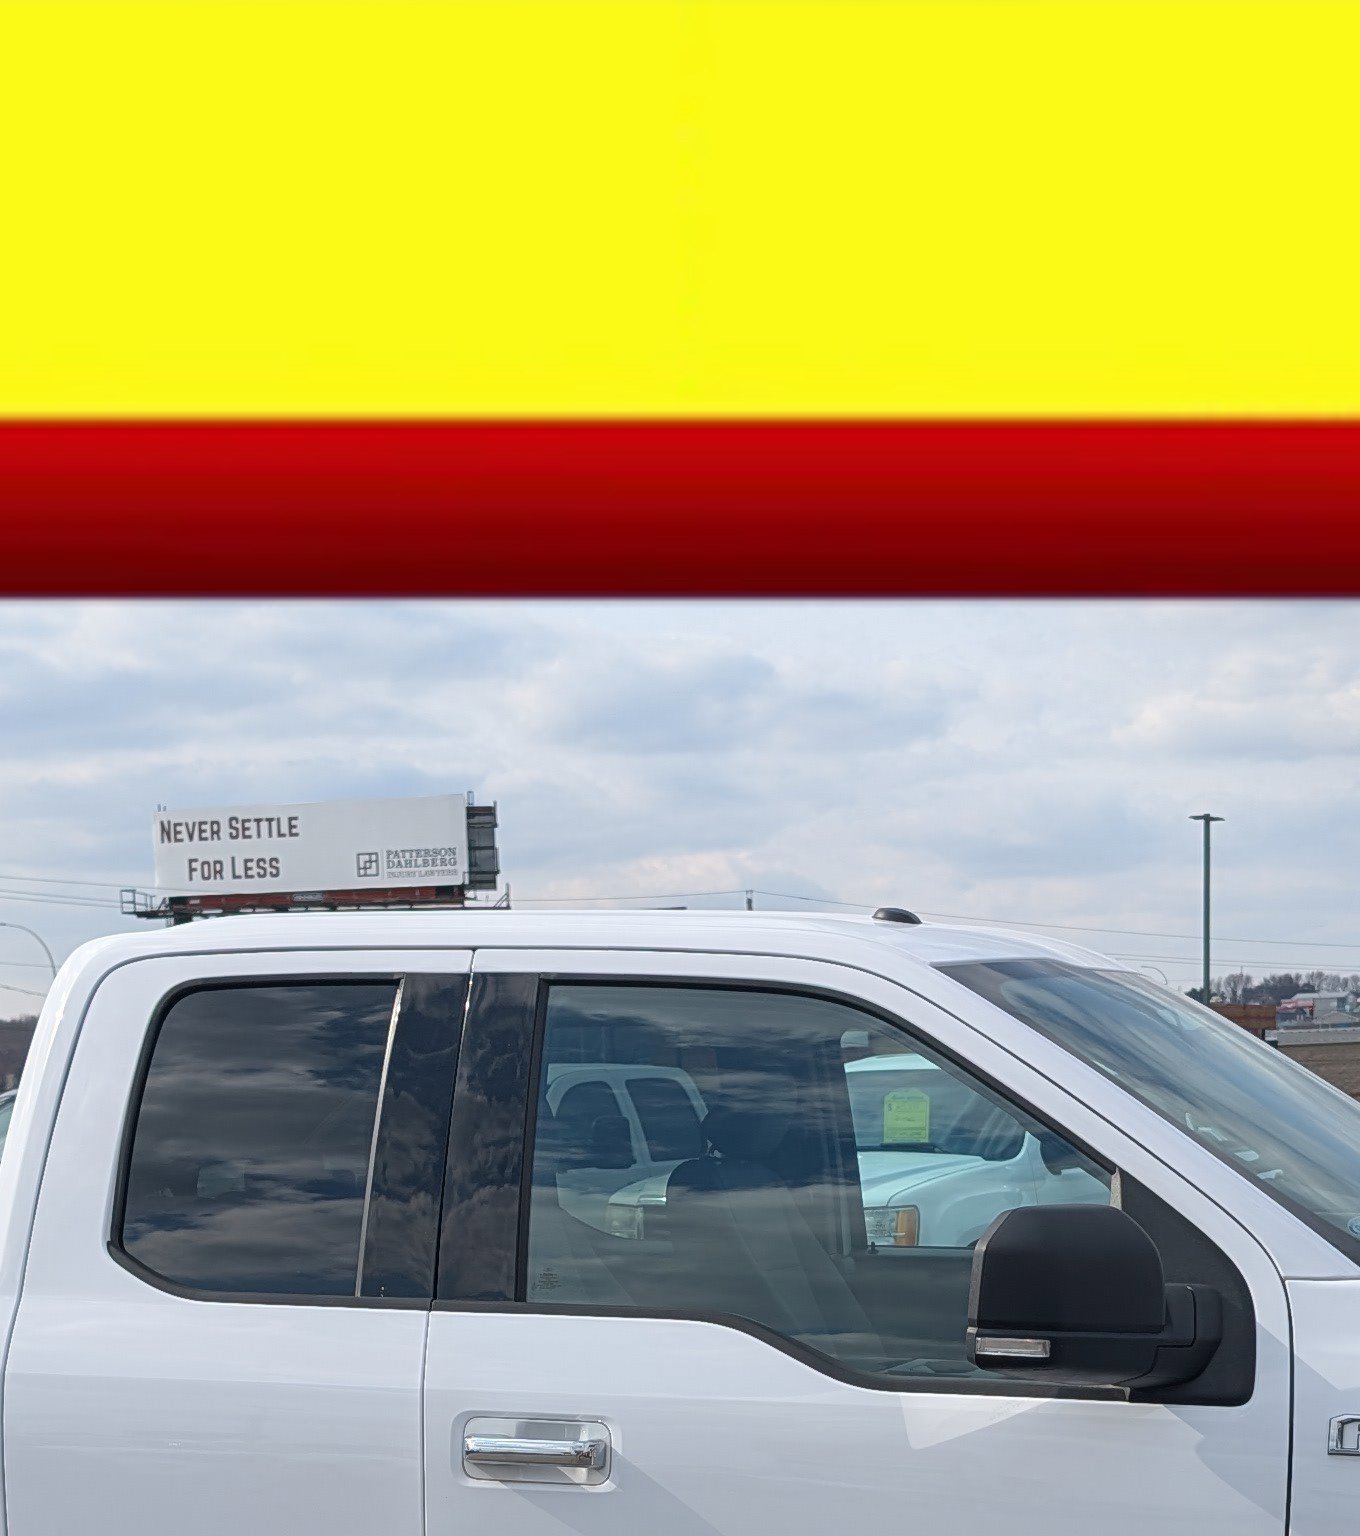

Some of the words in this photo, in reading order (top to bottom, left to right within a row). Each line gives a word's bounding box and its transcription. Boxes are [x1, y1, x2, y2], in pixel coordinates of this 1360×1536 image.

[159, 818, 221, 844] NEVER
[228, 815, 300, 841] SETTLE
[385, 847, 457, 860] PATTERSON
[188, 856, 224, 882] FOR
[231, 856, 281, 880] LESS
[386, 858, 457, 869] DAHLBERG
